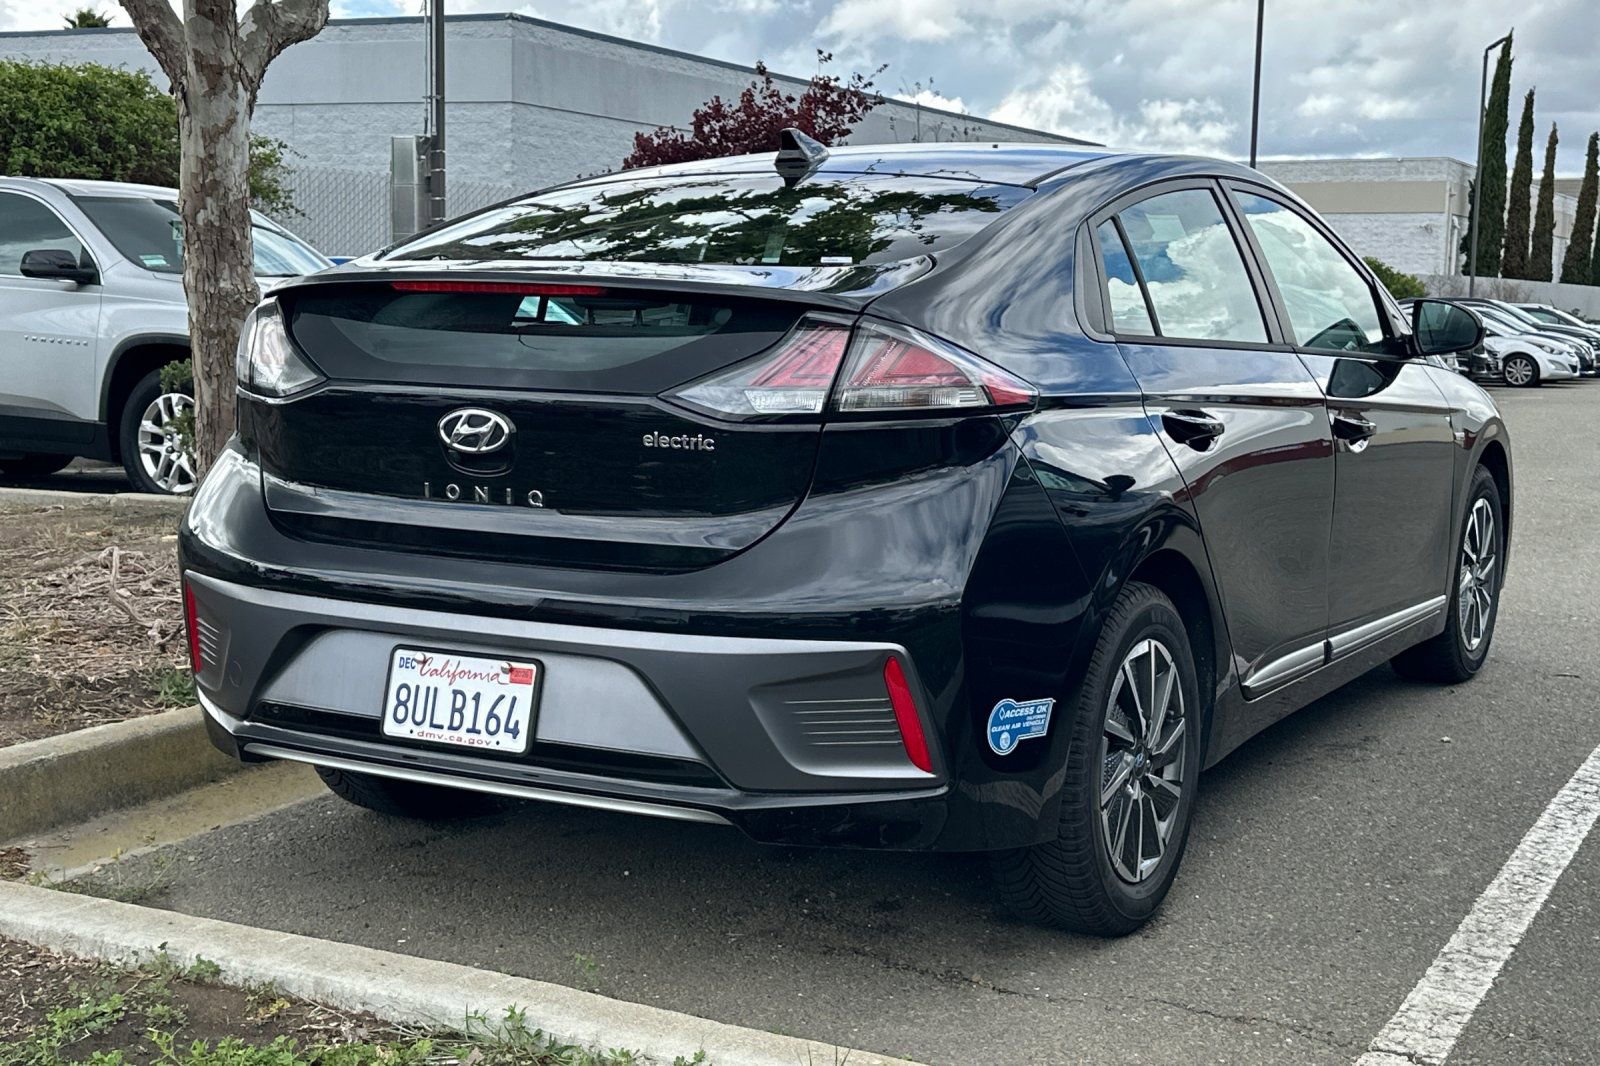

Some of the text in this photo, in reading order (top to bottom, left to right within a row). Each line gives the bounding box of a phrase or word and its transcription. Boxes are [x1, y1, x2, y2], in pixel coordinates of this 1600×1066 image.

[642, 431, 715, 451] electric
[424, 482, 543, 507] IONIQ
[398, 656, 416, 670] DEC
[419, 656, 509, 686] California
[393, 682, 520, 740] 8ULB164
[1004, 706, 1035, 719] ACCESS
[1036, 704, 1049, 714] OK
[991, 723, 1011, 733] CLEAN
[1011, 722, 1021, 730] AIR
[417, 729, 492, 746] dmv.ca.gov
